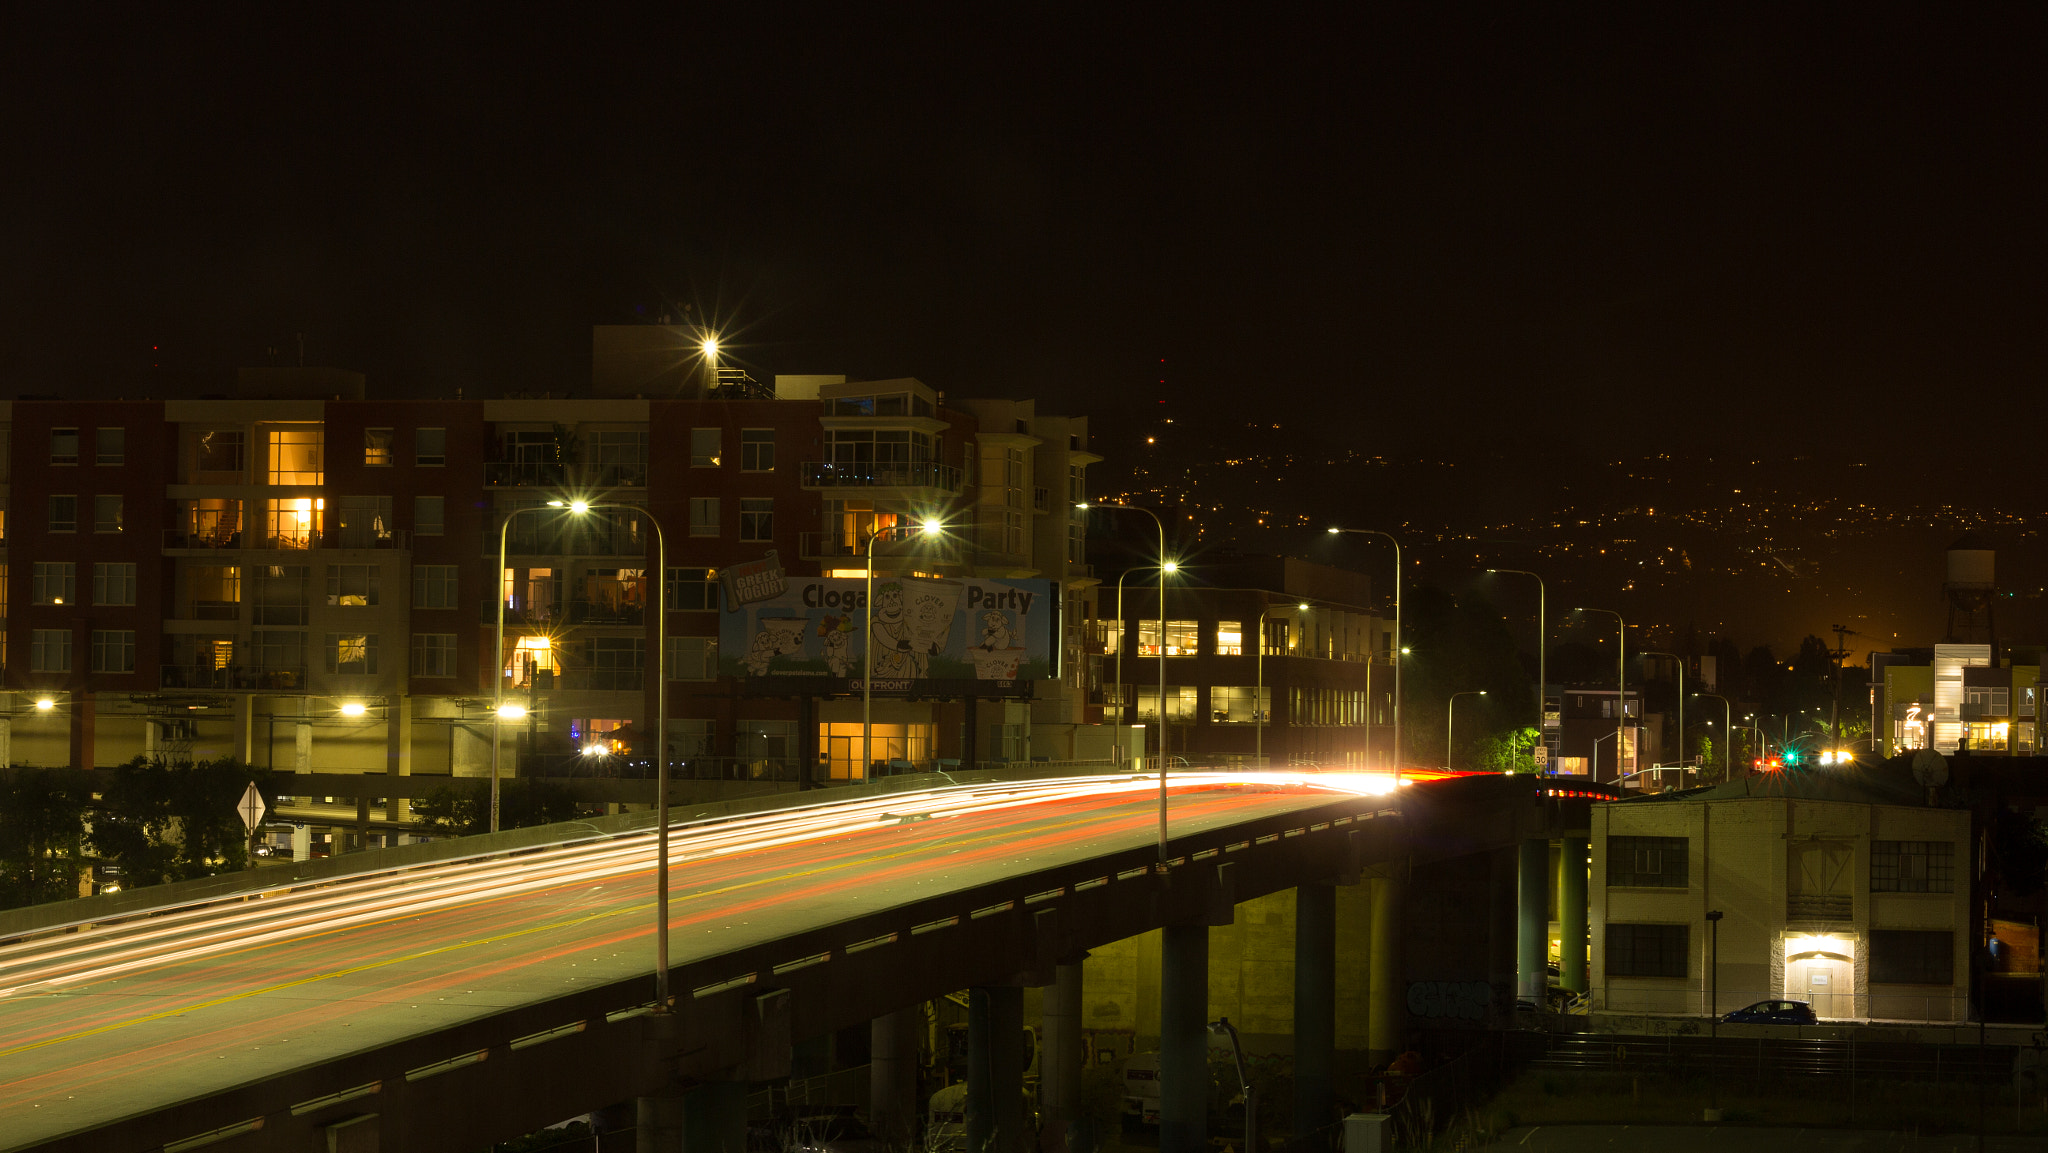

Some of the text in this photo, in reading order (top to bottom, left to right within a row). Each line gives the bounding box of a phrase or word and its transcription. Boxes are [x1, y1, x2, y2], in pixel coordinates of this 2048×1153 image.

[736, 568, 779, 589] GREEK
[736, 578, 785, 602] YOGURT
[968, 586, 1032, 615] Party
[915, 594, 945, 608] CLOVER
[1536, 756, 1546, 764] 30
